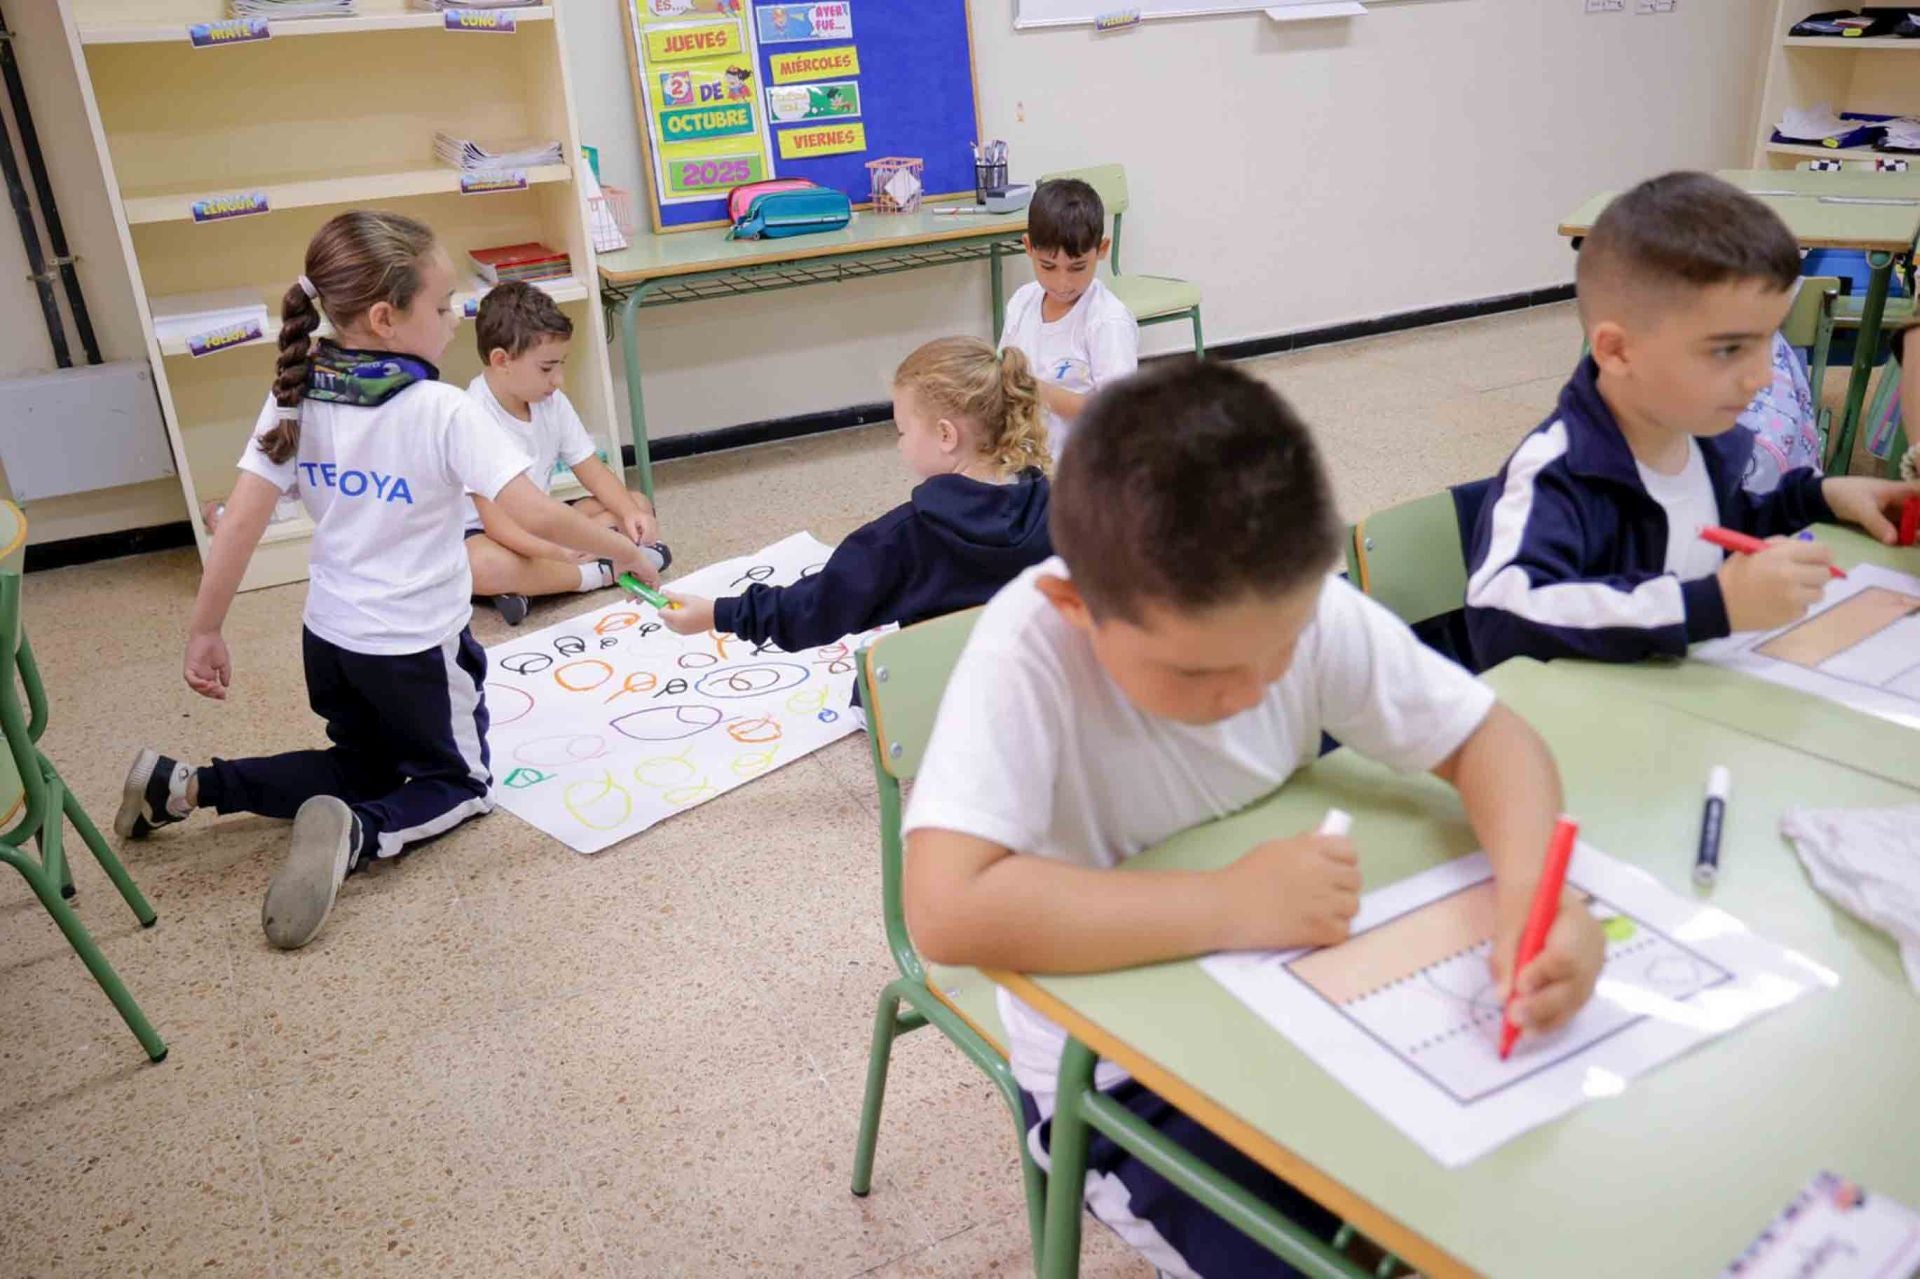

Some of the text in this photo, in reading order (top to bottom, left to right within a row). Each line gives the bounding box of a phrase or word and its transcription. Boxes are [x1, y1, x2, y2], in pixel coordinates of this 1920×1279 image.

[816, 5, 842, 17] AYER
[664, 30, 727, 53] JUEVES
[780, 55, 851, 76] MIÉRCOLES
[671, 79, 724, 102] 2 DE
[667, 108, 748, 133] OCTUBRE
[793, 130, 855, 149] VIERNES
[682, 159, 751, 186] 2025
[298, 462, 413, 504] TEOYA
